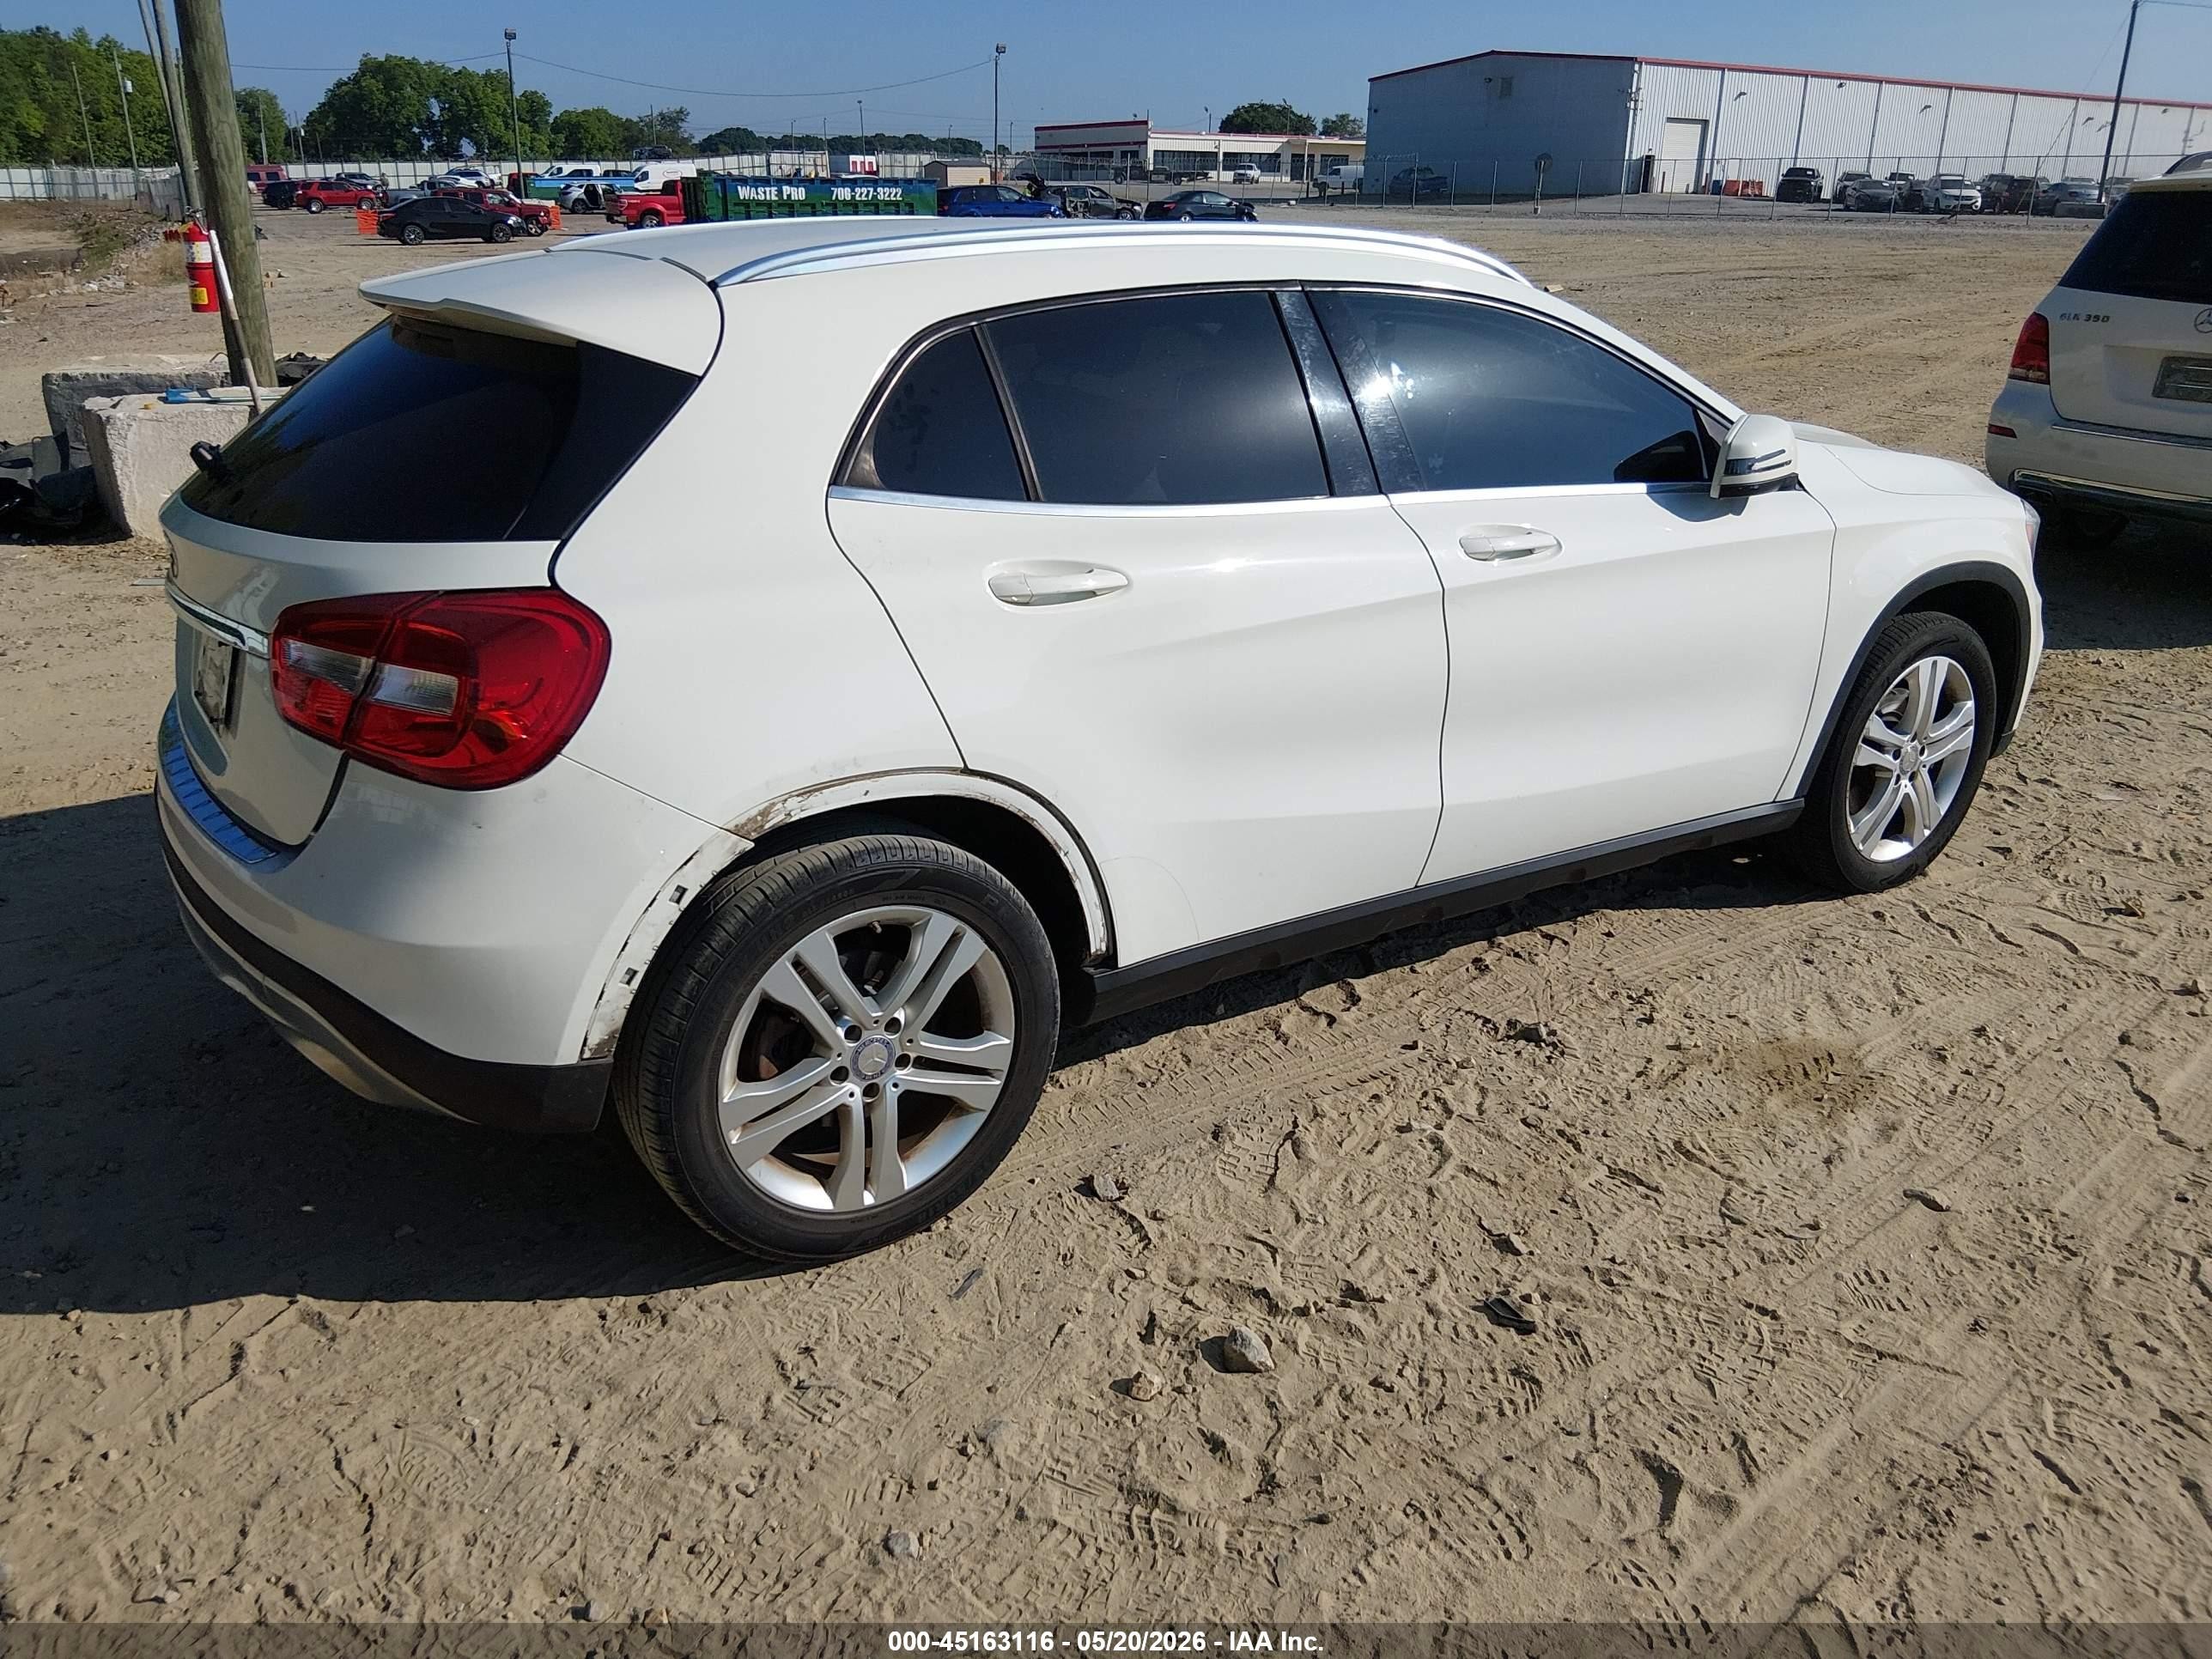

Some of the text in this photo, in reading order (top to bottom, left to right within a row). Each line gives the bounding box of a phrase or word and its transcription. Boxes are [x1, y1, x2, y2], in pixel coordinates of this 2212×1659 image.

[737, 185, 902, 201] WASTE PRO 706-227-3222
[2083, 313, 2111, 323] 350
